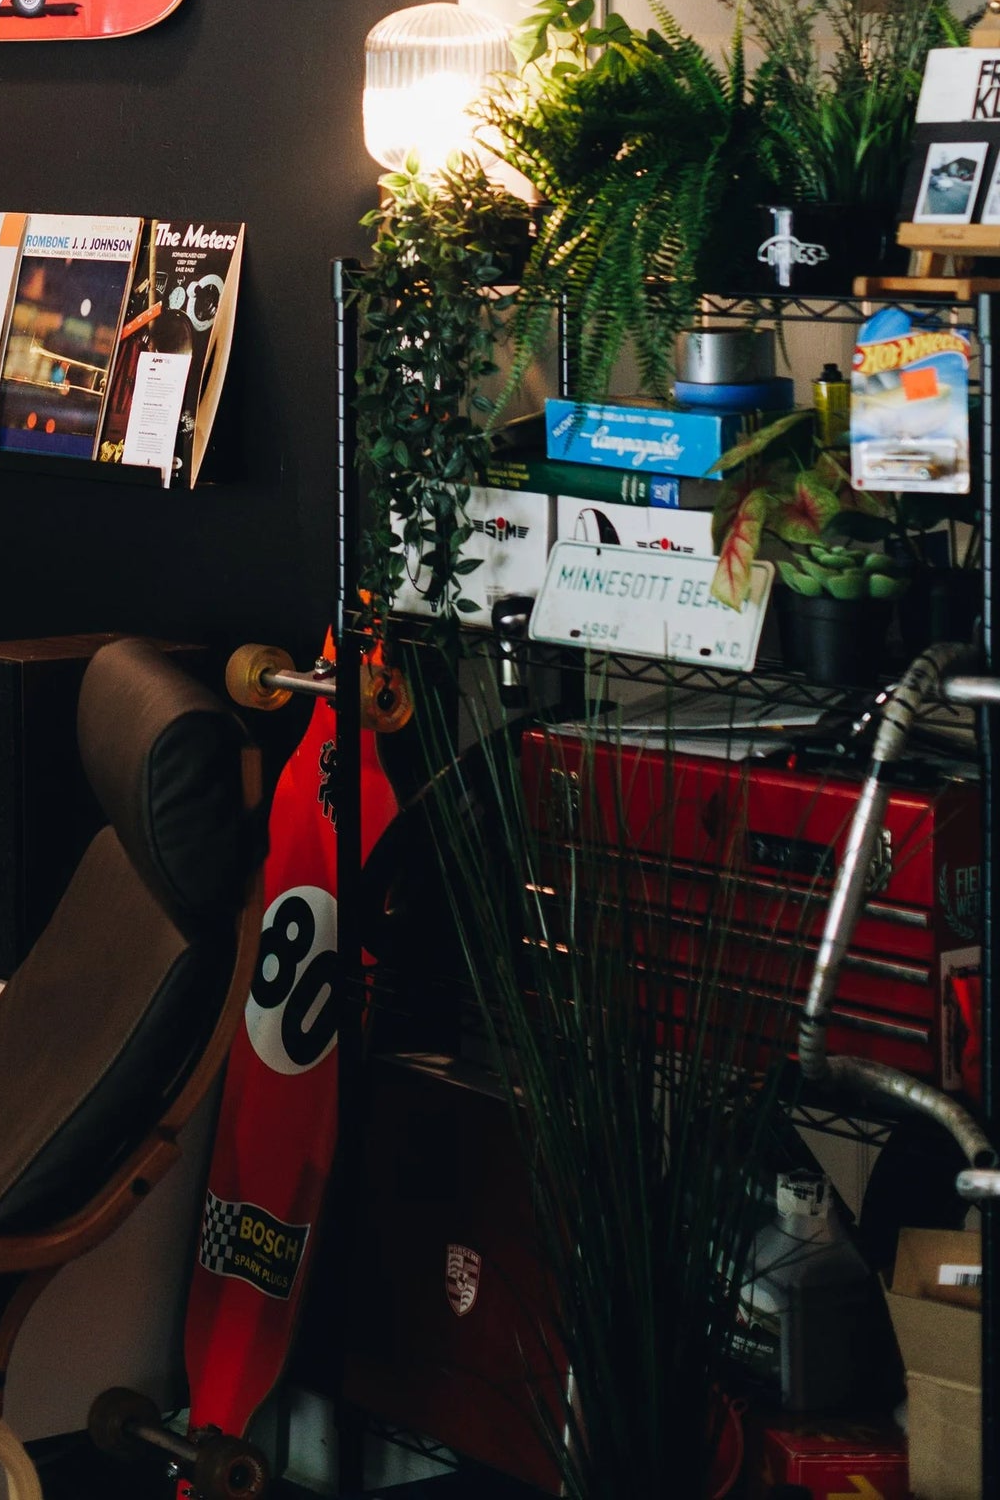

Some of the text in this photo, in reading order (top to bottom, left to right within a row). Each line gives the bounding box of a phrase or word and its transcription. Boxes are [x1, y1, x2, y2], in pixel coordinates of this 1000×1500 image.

[90, 239, 132, 252] JOHNSON
[155, 223, 238, 250] The Meters
[557, 564, 673, 602] MINNESOTT
[250, 896, 338, 1066] 80
[239, 1216, 299, 1263] BOSCH
[234, 1254, 261, 1276] SPARK
[261, 1267, 288, 1288] PLUGS
